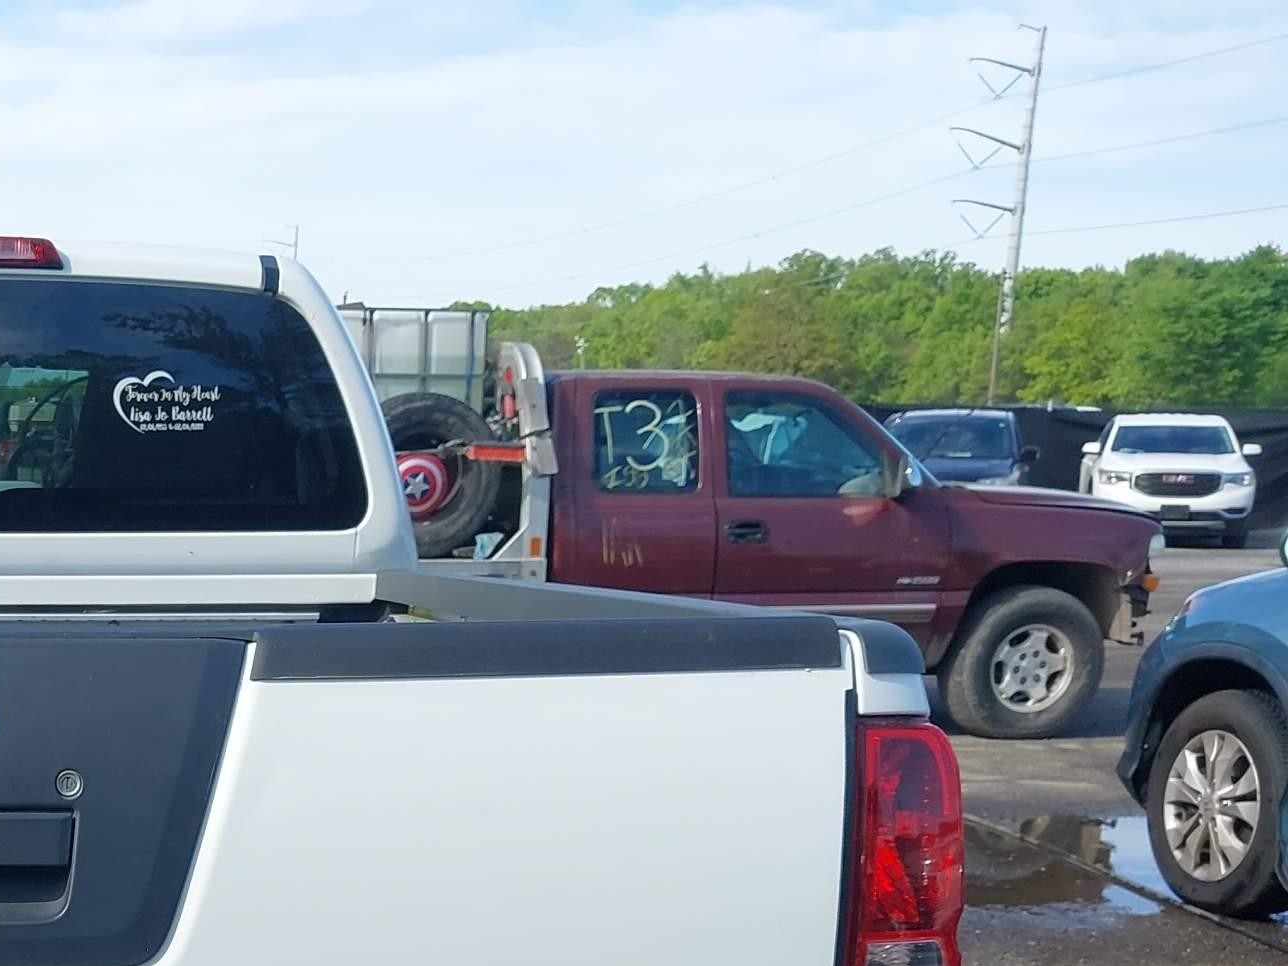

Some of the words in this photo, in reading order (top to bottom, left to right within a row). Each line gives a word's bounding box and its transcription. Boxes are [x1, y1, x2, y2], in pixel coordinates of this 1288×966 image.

[124, 385, 159, 402] Forever
[173, 385, 190, 406] My
[191, 385, 221, 402] Heart
[130, 406, 152, 423] Lisa
[155, 406, 169, 421] Jo
[172, 405, 214, 422] Barrell
[1162, 475, 1194, 484] GMC
